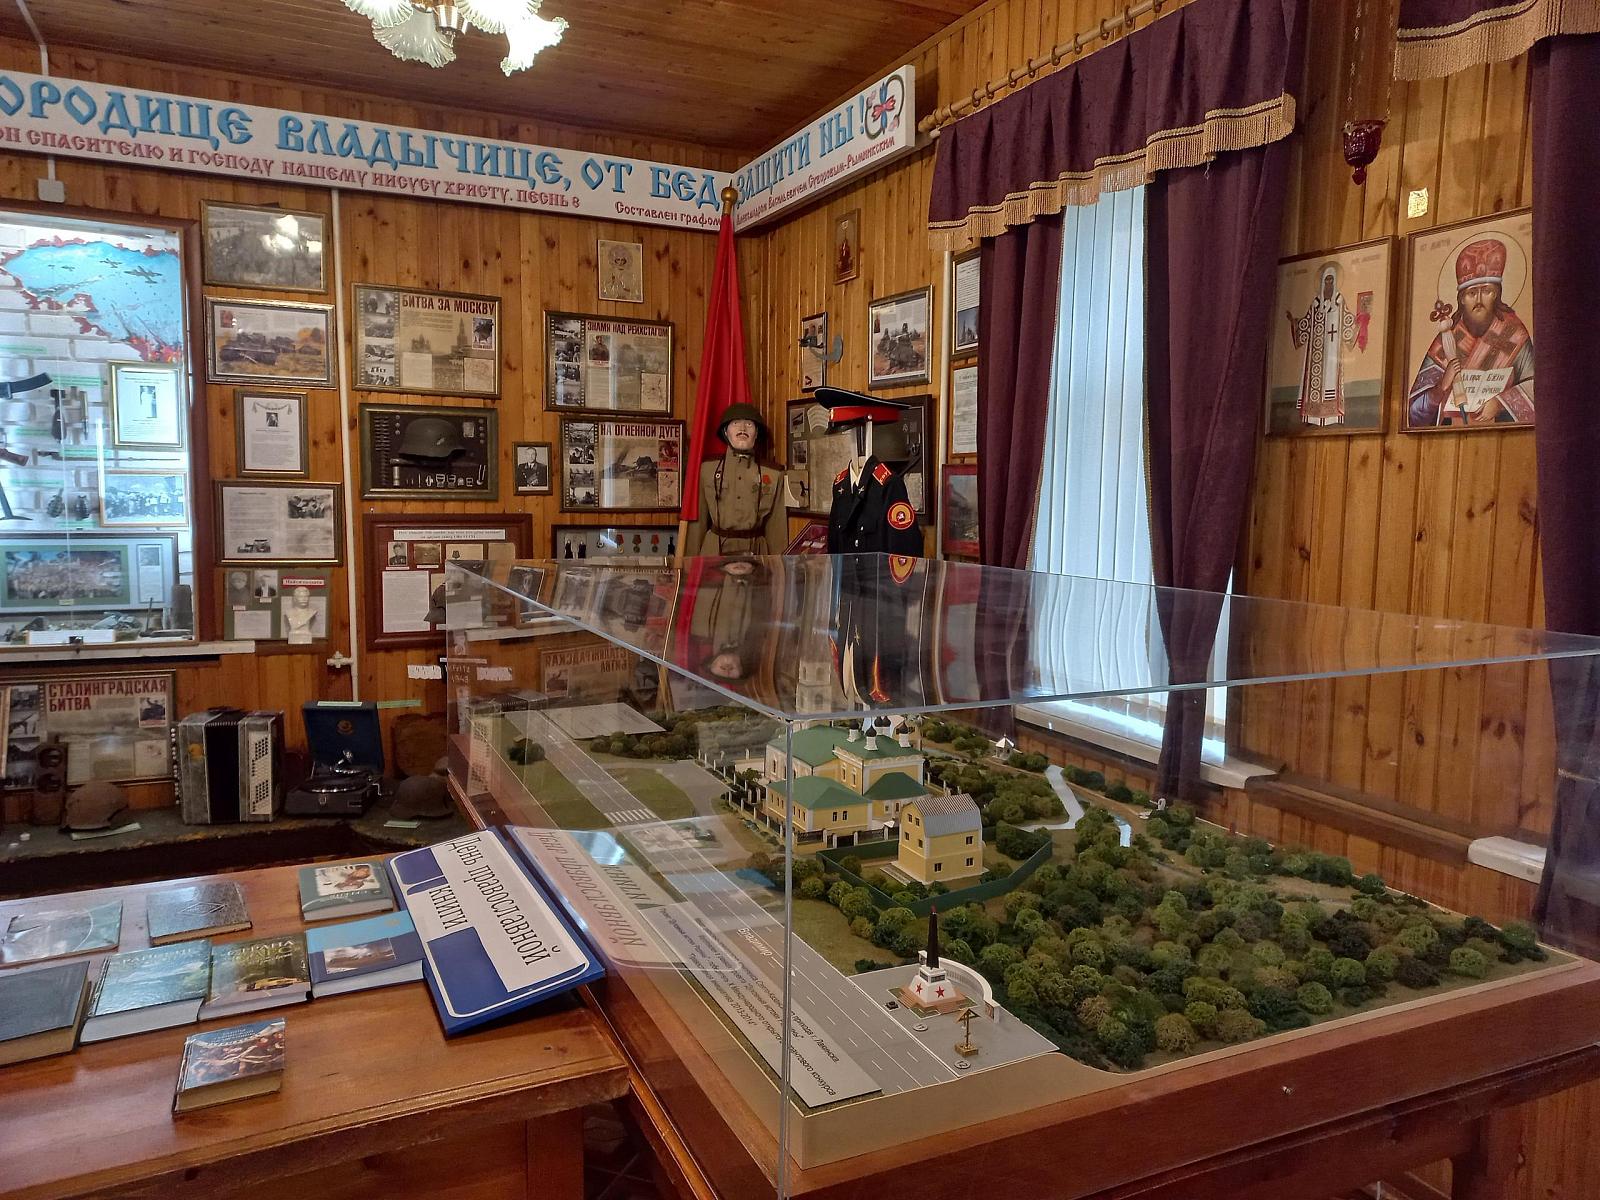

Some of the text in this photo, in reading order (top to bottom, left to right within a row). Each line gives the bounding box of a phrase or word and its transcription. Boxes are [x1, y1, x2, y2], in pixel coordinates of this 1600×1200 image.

[26, 129, 164, 160] СПАСИТЕЛЮ
[169, 146, 183, 162] И
[188, 150, 275, 177] ГОСПОДУ
[282, 162, 367, 188] НАШЕМУ
[515, 189, 568, 207] ПЕСНЬ
[275, 115, 572, 192] ВЛАДЫЧИЦЕ,
[581, 157, 633, 193] ОТ
[650, 166, 720, 212] БЕД
[736, 131, 811, 210] ЗАЩИТИ
[767, 183, 808, 210] Васильевичем
[614, 201, 720, 228] Составлен графом
[402, 295, 495, 315] БИТВА ЗА МОСКВУ
[587, 321, 611, 333] ЗНАМЯ
[612, 323, 626, 335] НАД
[600, 423, 680, 439] НА ОГНЕННОЙ ДУГЕ
[49, 679, 168, 698] СТАЛИНГРАДСКАЯ
[49, 697, 92, 713] БИТВА
[428, 884, 469, 930] книги
[447, 833, 561, 966] День православной
[786, 1042, 814, 1072] рантового
[811, 1069, 837, 1096] конкурса
